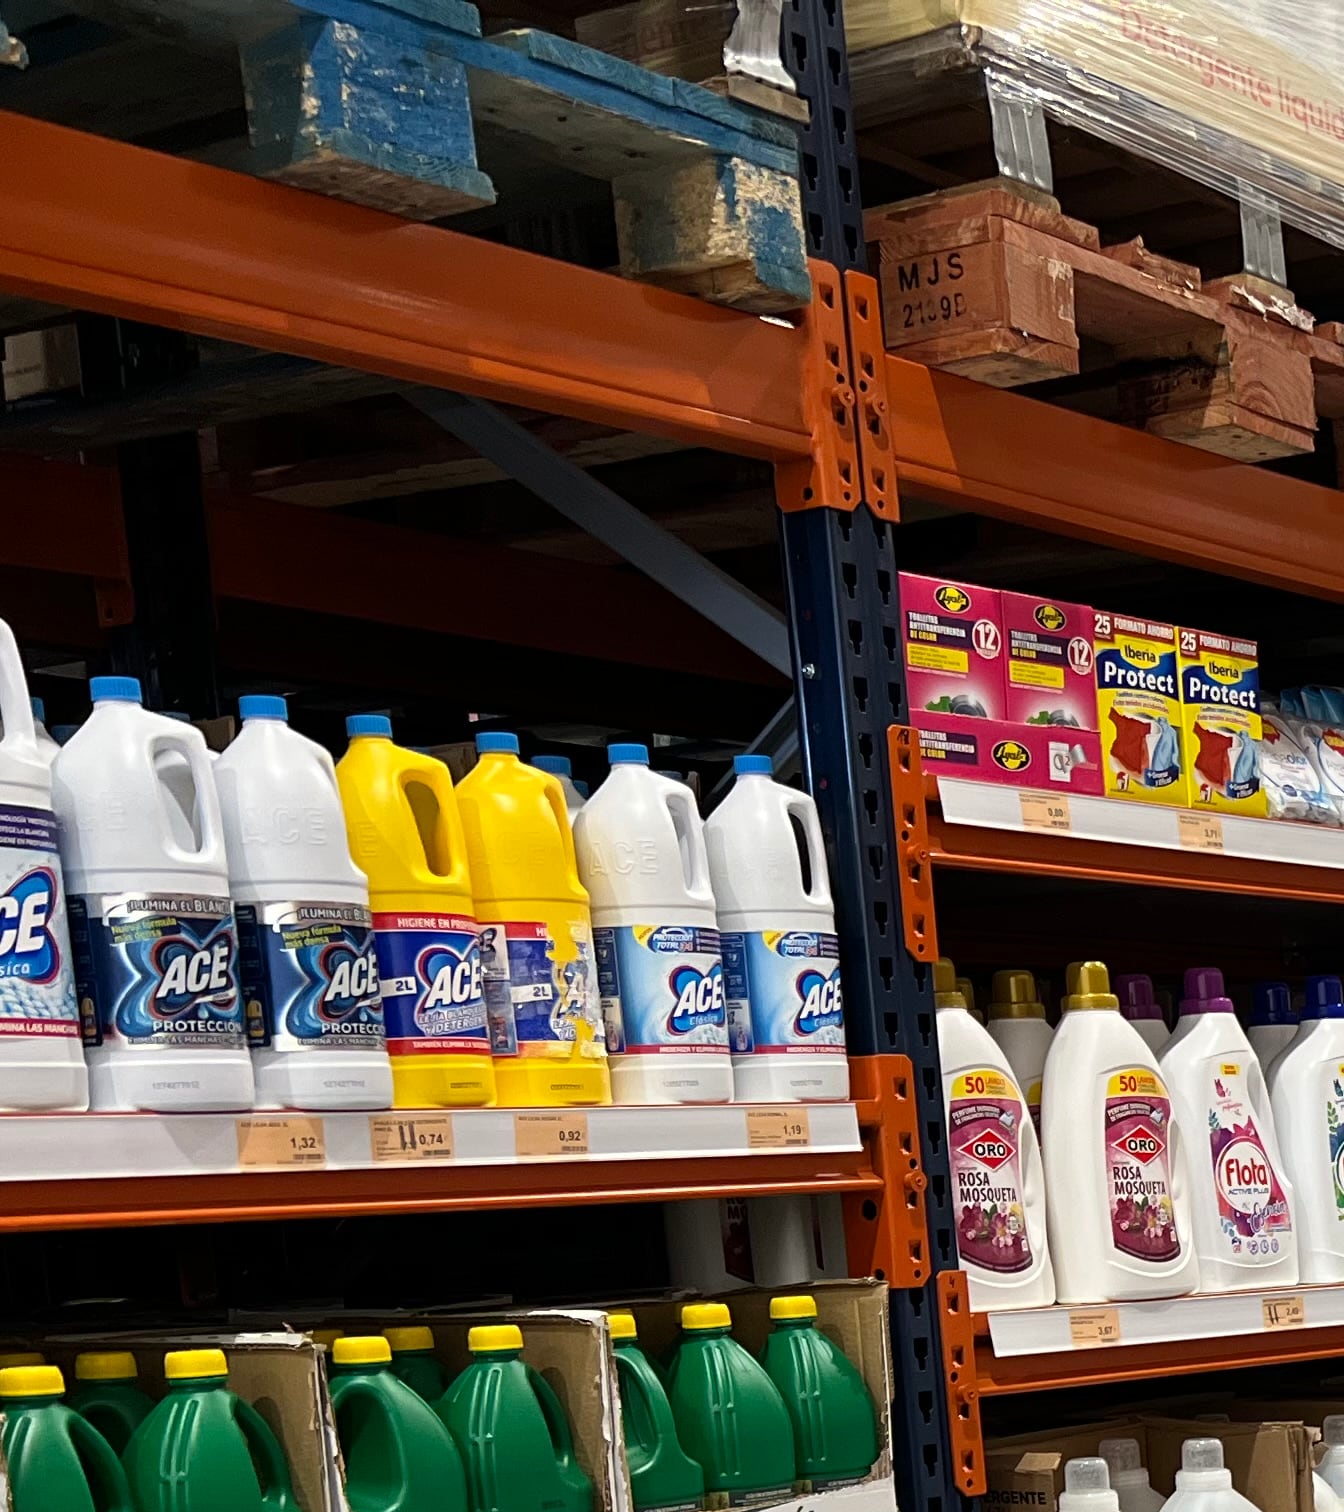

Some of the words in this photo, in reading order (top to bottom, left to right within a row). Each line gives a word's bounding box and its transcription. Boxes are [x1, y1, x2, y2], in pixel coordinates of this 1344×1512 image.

[1094, 614, 1111, 634] 25
[1114, 617, 1145, 635] FORMATO
[1147, 623, 1173, 640] AHORRO
[976, 625, 997, 651] 12
[1123, 641, 1157, 663] Iberia
[1104, 660, 1174, 694] Protect
[1189, 677, 1256, 709] Protect
[398, 917, 436, 931] HIGIENE
[439, 919, 451, 929] EN
[155, 943, 229, 1000] ACE
[325, 945, 377, 1002] ACE
[396, 981, 413, 993] 2L
[425, 958, 482, 1009] ACE
[674, 972, 721, 1018] ACE
[800, 970, 842, 1017] ACE
[965, 1077, 984, 1094] 50
[559, 1129, 581, 1143] 0,92
[783, 1124, 801, 1136] 1,19
[290, 1137, 316, 1150] 1,32
[419, 1133, 443, 1145] 0,74
[1128, 1139, 1156, 1152] ORO
[975, 1143, 1006, 1157] ORO
[958, 1172, 989, 1187] ROSA
[1113, 1166, 1142, 1180] ROSA
[1225, 1159, 1268, 1187] Flota
[960, 1188, 1017, 1203] MOSQUETA
[1114, 1181, 1166, 1195] MOSQUETA
